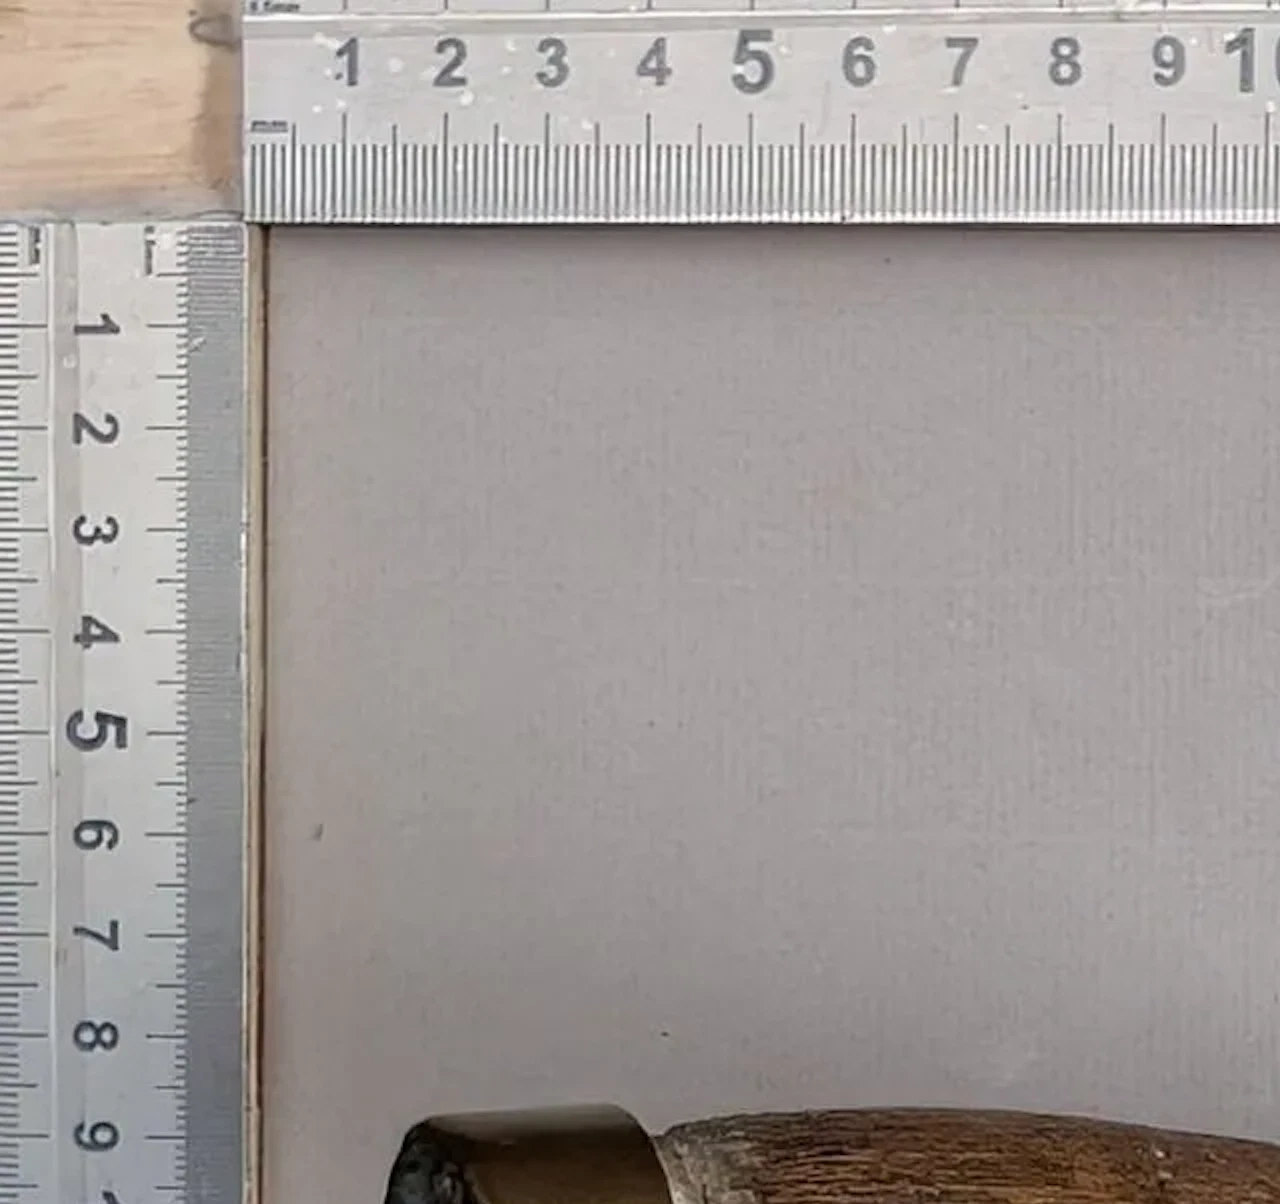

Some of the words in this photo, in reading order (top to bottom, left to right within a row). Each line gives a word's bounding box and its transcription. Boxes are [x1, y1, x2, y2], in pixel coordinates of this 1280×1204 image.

[335, 36, 359, 87] 1
[432, 37, 468, 88] 2
[535, 37, 570, 88] 3
[635, 36, 673, 87] 4
[731, 28, 774, 95] 5
[841, 36, 877, 88] 6
[943, 36, 979, 87] 7
[1048, 36, 1082, 87] 8
[1151, 35, 1186, 87] 9
[72, 313, 121, 337] 1
[72, 411, 120, 446] 2
[72, 514, 120, 546] 3
[72, 615, 121, 650] 4
[65, 708, 128, 752] 5
[72, 819, 119, 851] 6
[72, 919, 120, 952] 7
[72, 1020, 120, 1052] 8
[73, 1121, 120, 1152] 9
